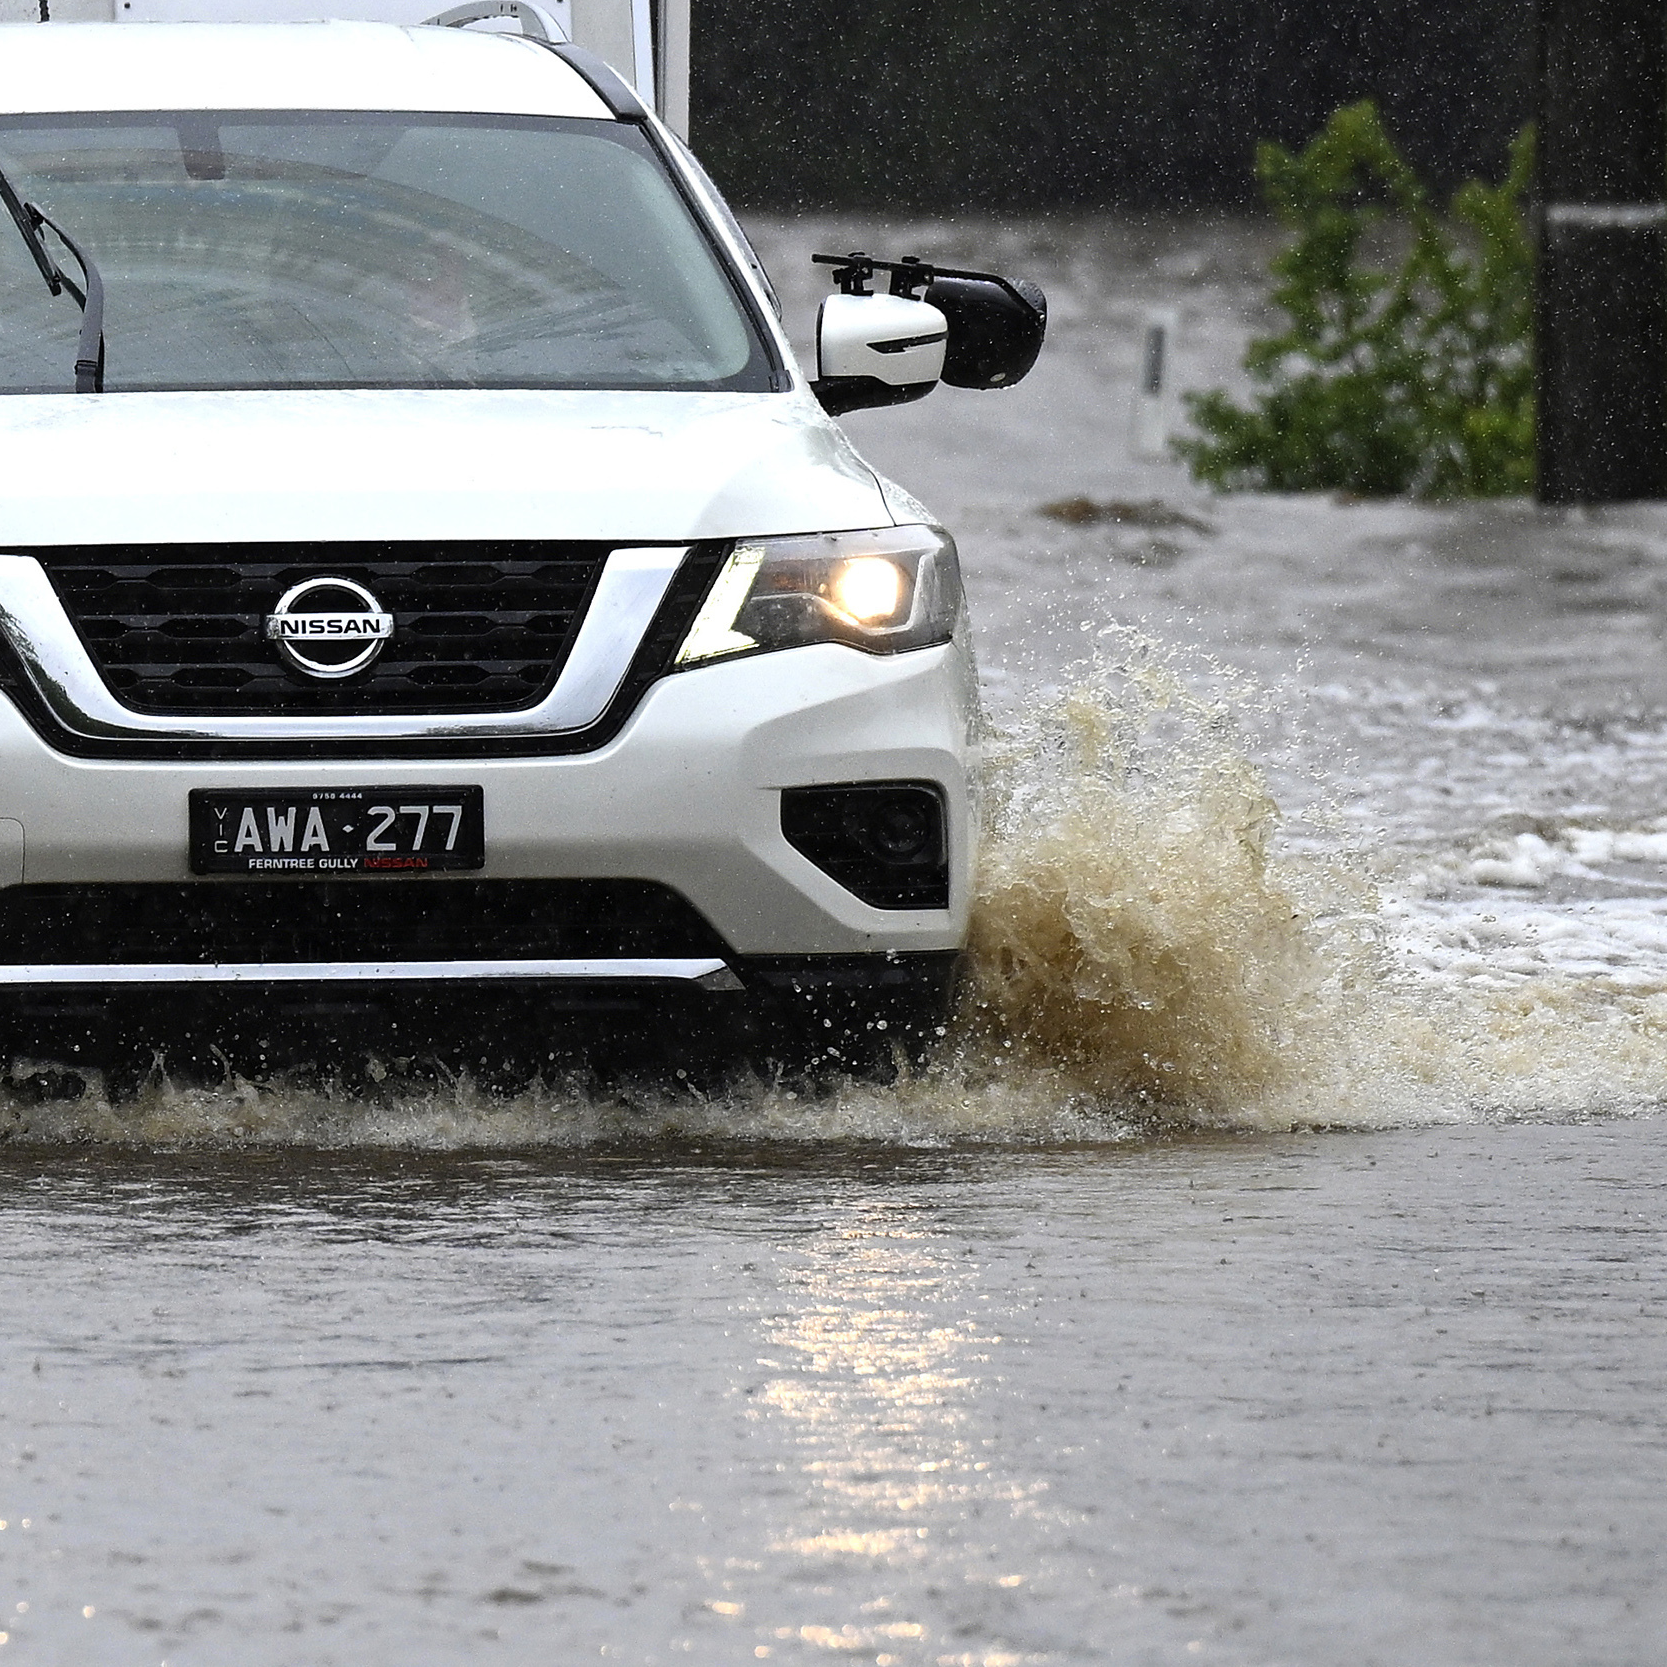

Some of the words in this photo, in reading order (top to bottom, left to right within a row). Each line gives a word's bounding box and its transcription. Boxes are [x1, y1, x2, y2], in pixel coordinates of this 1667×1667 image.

[281, 619, 380, 634] NISSAN
[214, 807, 228, 853] VIC
[234, 806, 329, 852] AWA
[366, 805, 462, 851] 277
[248, 858, 315, 869] FERNTREE
[319, 858, 358, 869] GULLY
[364, 858, 428, 869] NISSAN
